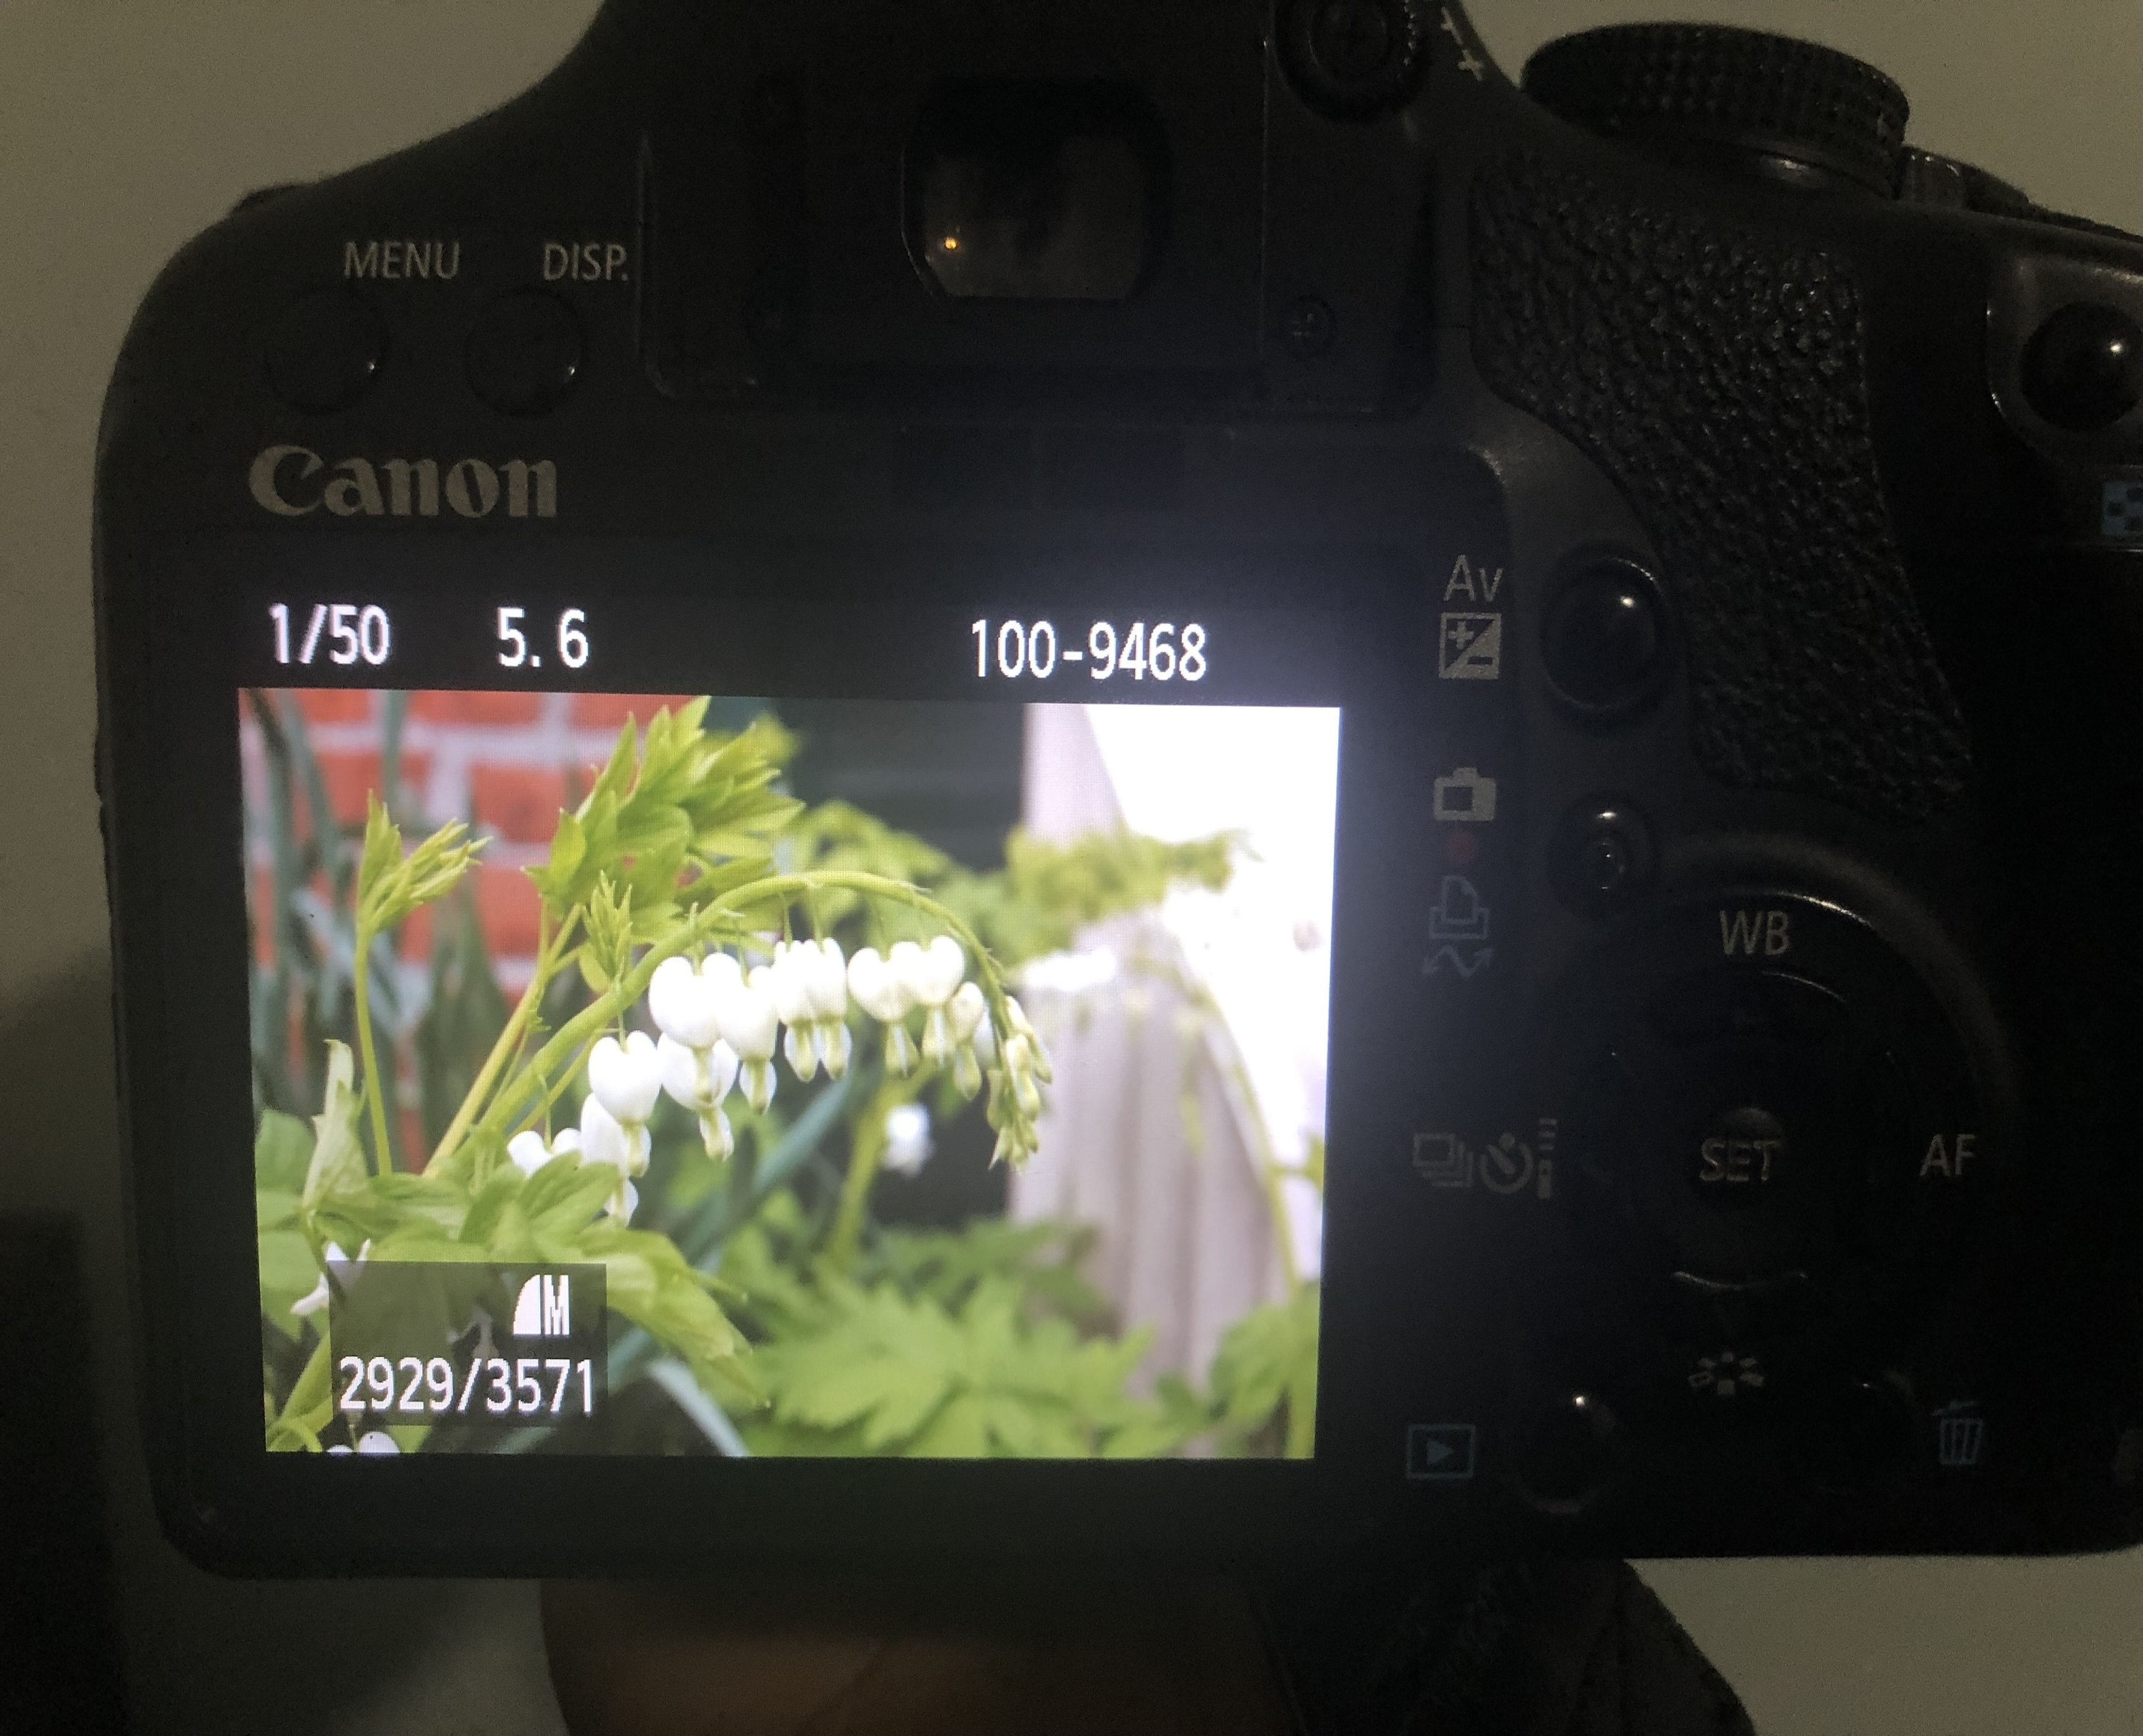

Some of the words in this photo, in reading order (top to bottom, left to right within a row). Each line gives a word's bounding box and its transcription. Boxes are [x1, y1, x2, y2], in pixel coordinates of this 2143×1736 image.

[344, 241, 461, 280] MENU
[542, 242, 629, 281] DISP.
[249, 445, 558, 518] Canon
[1444, 554, 1503, 601] Av
[269, 603, 391, 665] 1/50
[972, 619, 1207, 681] 100-9468
[1719, 910, 1790, 955] WB
[1700, 1138, 1781, 1182] SET
[1920, 1133, 1977, 1177] AF
[339, 1355, 593, 1415] 2929/3571
